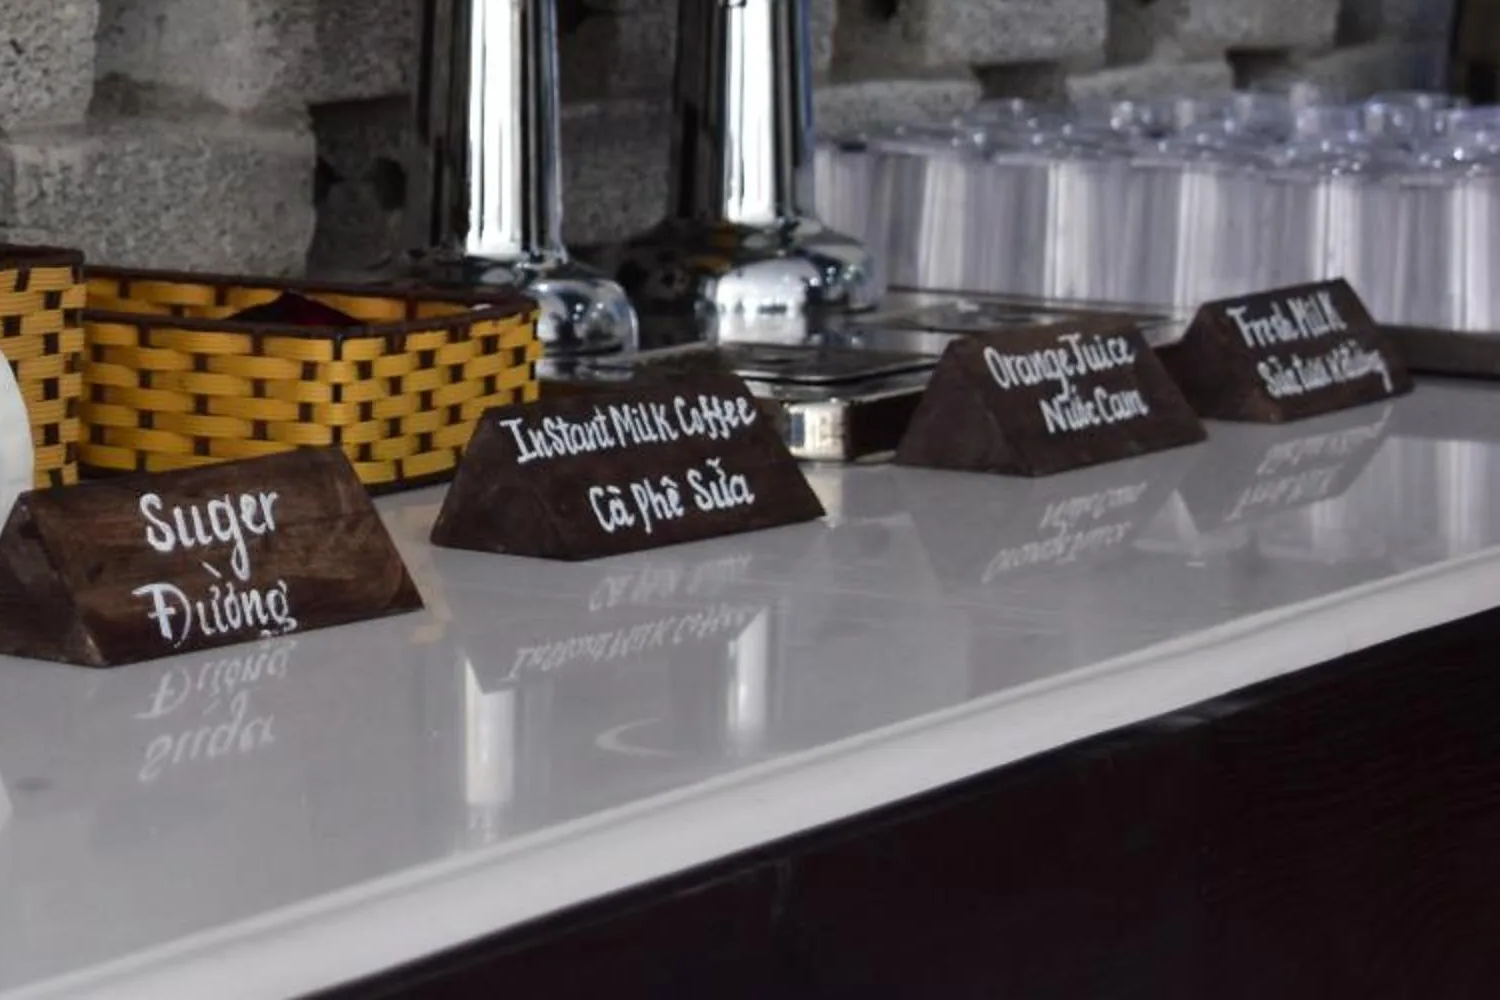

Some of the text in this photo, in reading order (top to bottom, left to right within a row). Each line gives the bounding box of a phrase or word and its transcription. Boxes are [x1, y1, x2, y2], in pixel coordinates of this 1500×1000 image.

[984, 333, 1136, 400] Orange Juice
[675, 395, 757, 440] Coffee
[139, 492, 278, 581] Suger
